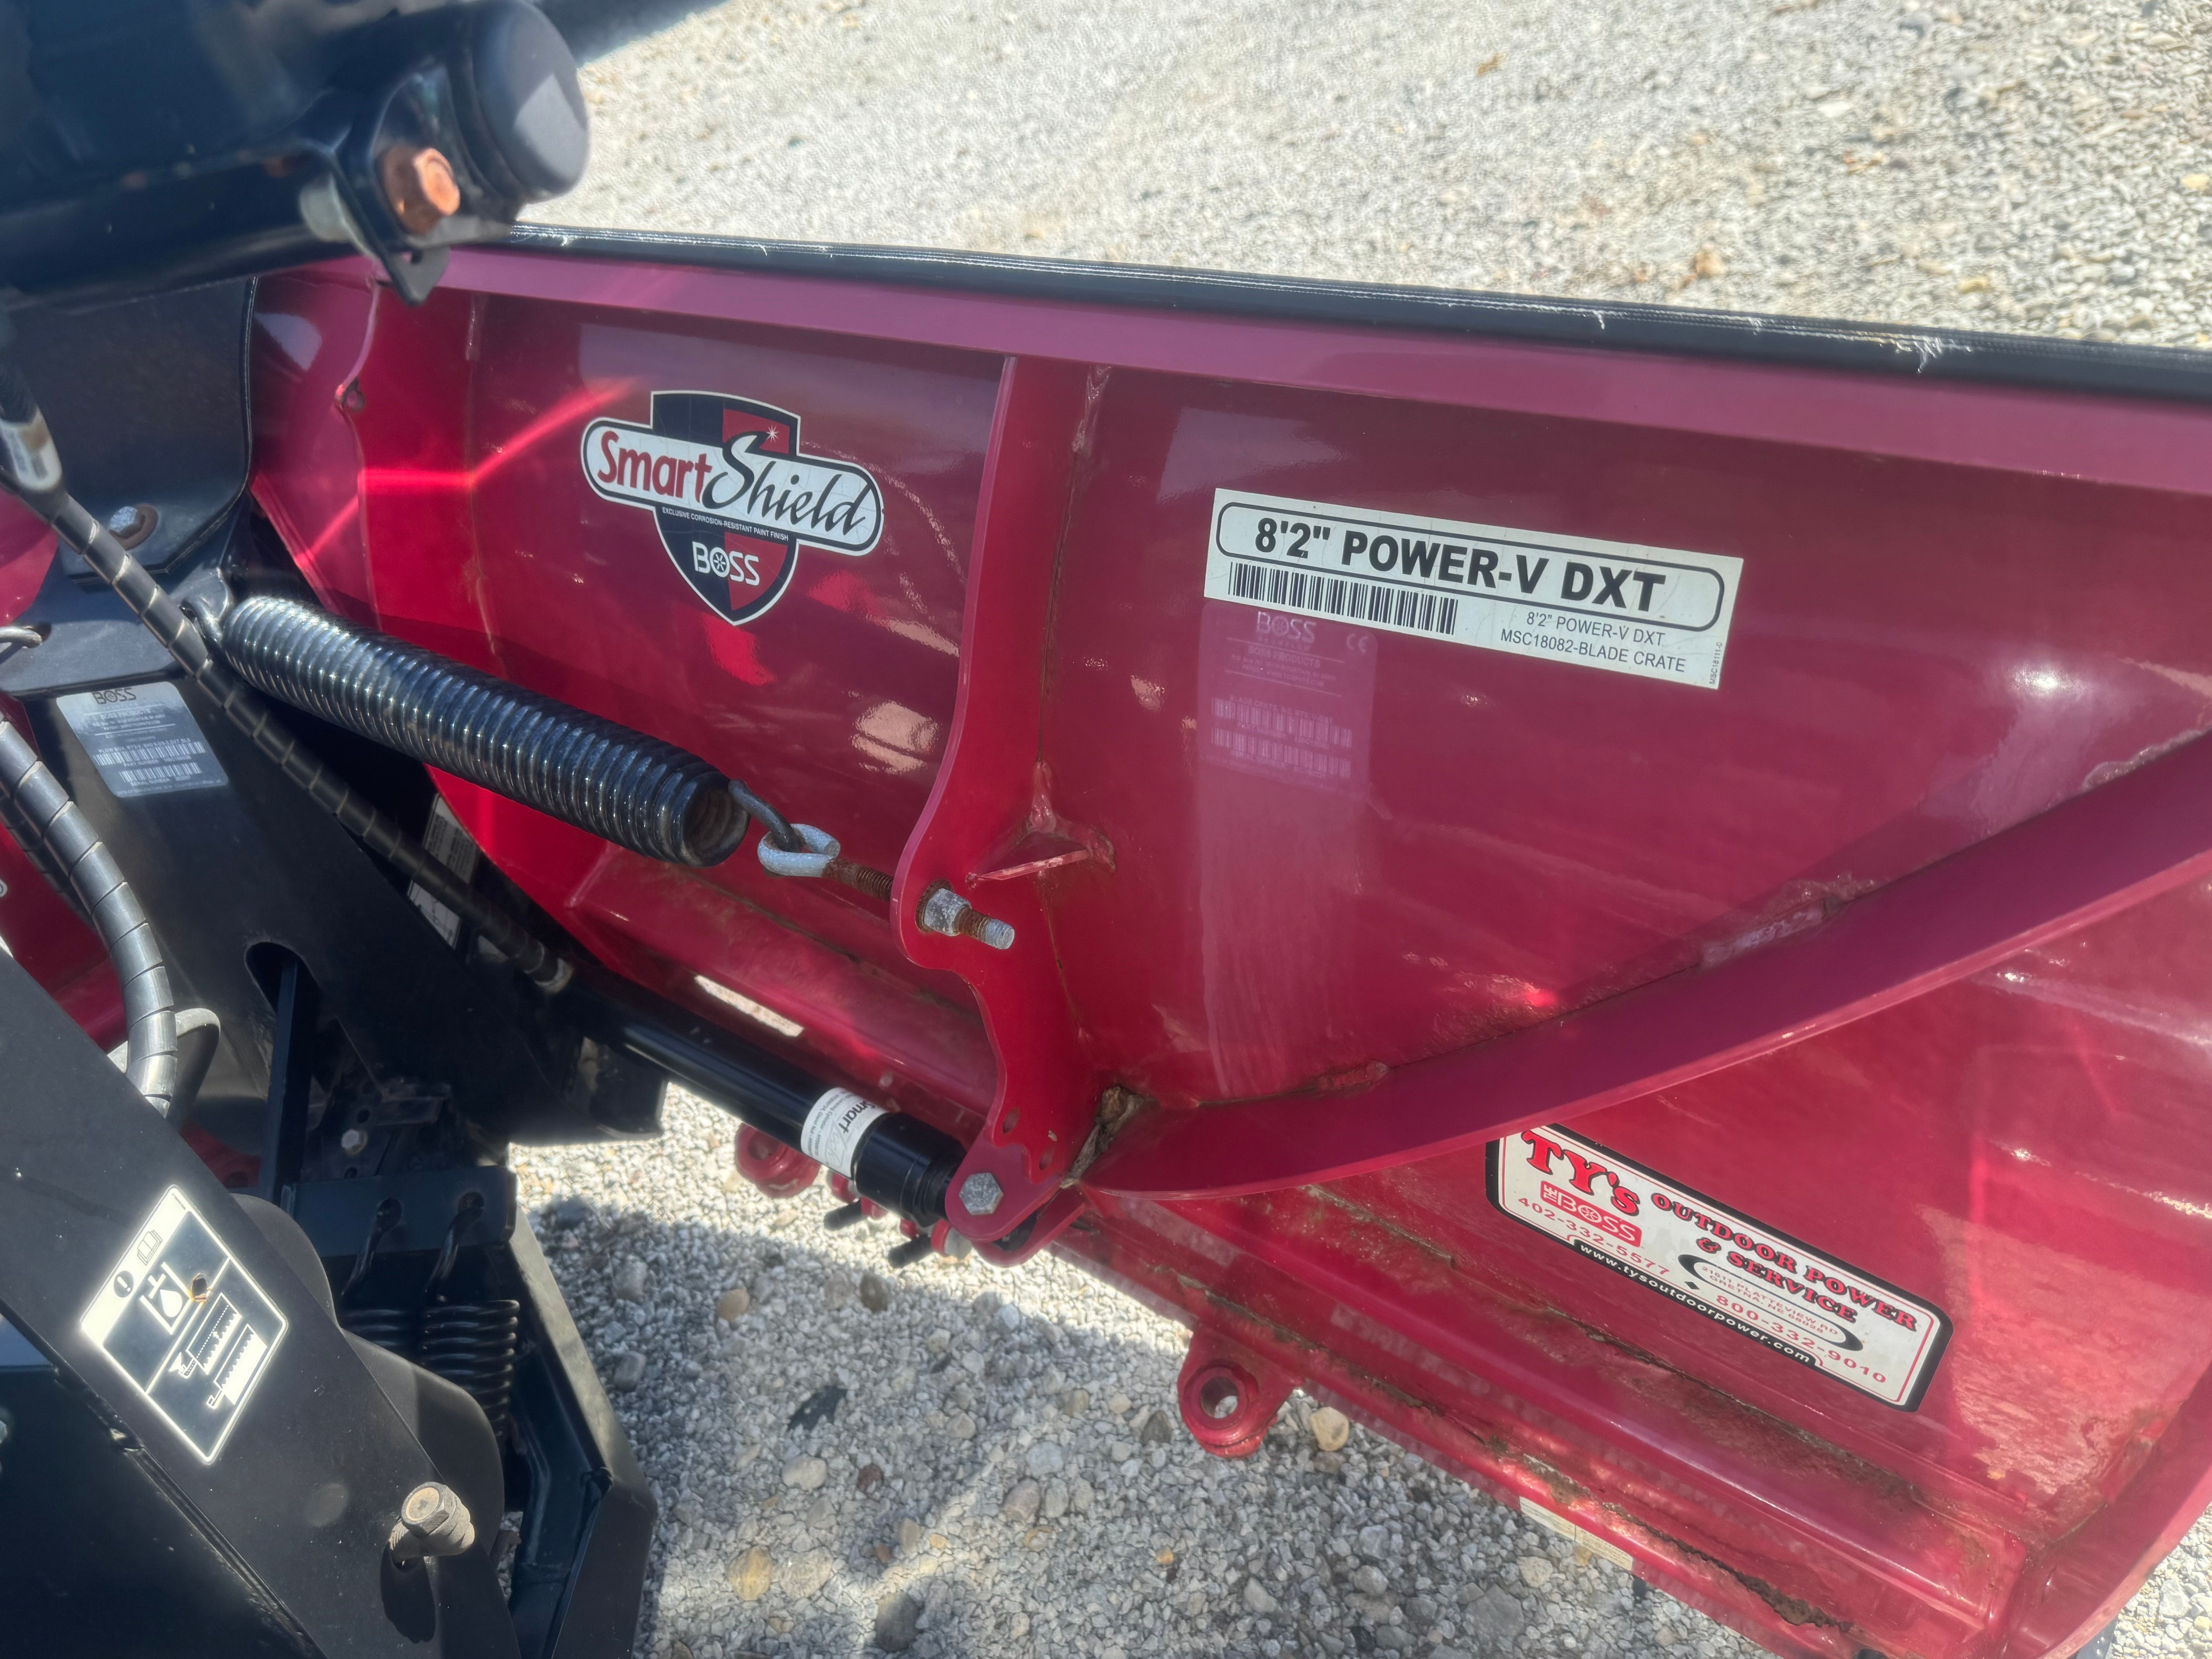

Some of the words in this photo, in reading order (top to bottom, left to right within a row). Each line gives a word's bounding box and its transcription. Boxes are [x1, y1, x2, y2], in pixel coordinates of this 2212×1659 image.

[662, 507, 690, 519] EXCLUSIVE
[691, 513, 753, 533] CORROSION-RESISTANT
[754, 527, 769, 537] PAINT
[770, 531, 788, 541] FINISH
[692, 541, 759, 586] BOSS
[1255, 517, 1331, 559] 8'2"
[1341, 530, 1549, 594] POWER-V
[1561, 562, 1666, 612] DXT
[1257, 611, 1316, 643] BOSS
[1501, 629, 1628, 662] MSC18082-BLADE
[1634, 651, 1686, 672] CRATE
[1556, 615, 1629, 640] POWER-V
[1633, 630, 1665, 646] DXT
[1273, 652, 1321, 669] PRODUCTS
[92, 687, 136, 705] BOSS
[1518, 1197, 1670, 1275] 402-332-5577
[1544, 1183, 1558, 1203] THE
[1557, 1191, 1637, 1242] BOSS
[1650, 1193, 1798, 1274] OUTDOOR
[1805, 1264, 1917, 1332] POWER
[1696, 1237, 1722, 1255] &
[1726, 1251, 1858, 1323] SERVICE
[1580, 1244, 1810, 1363] www.tysoutdoorpower.com
[1737, 1282, 1816, 1324] PLATTEVIEW
[1820, 1323, 1838, 1334] RD
[1768, 1304, 1784, 1314] NE
[1716, 1294, 1886, 1384] 800-332-9010
